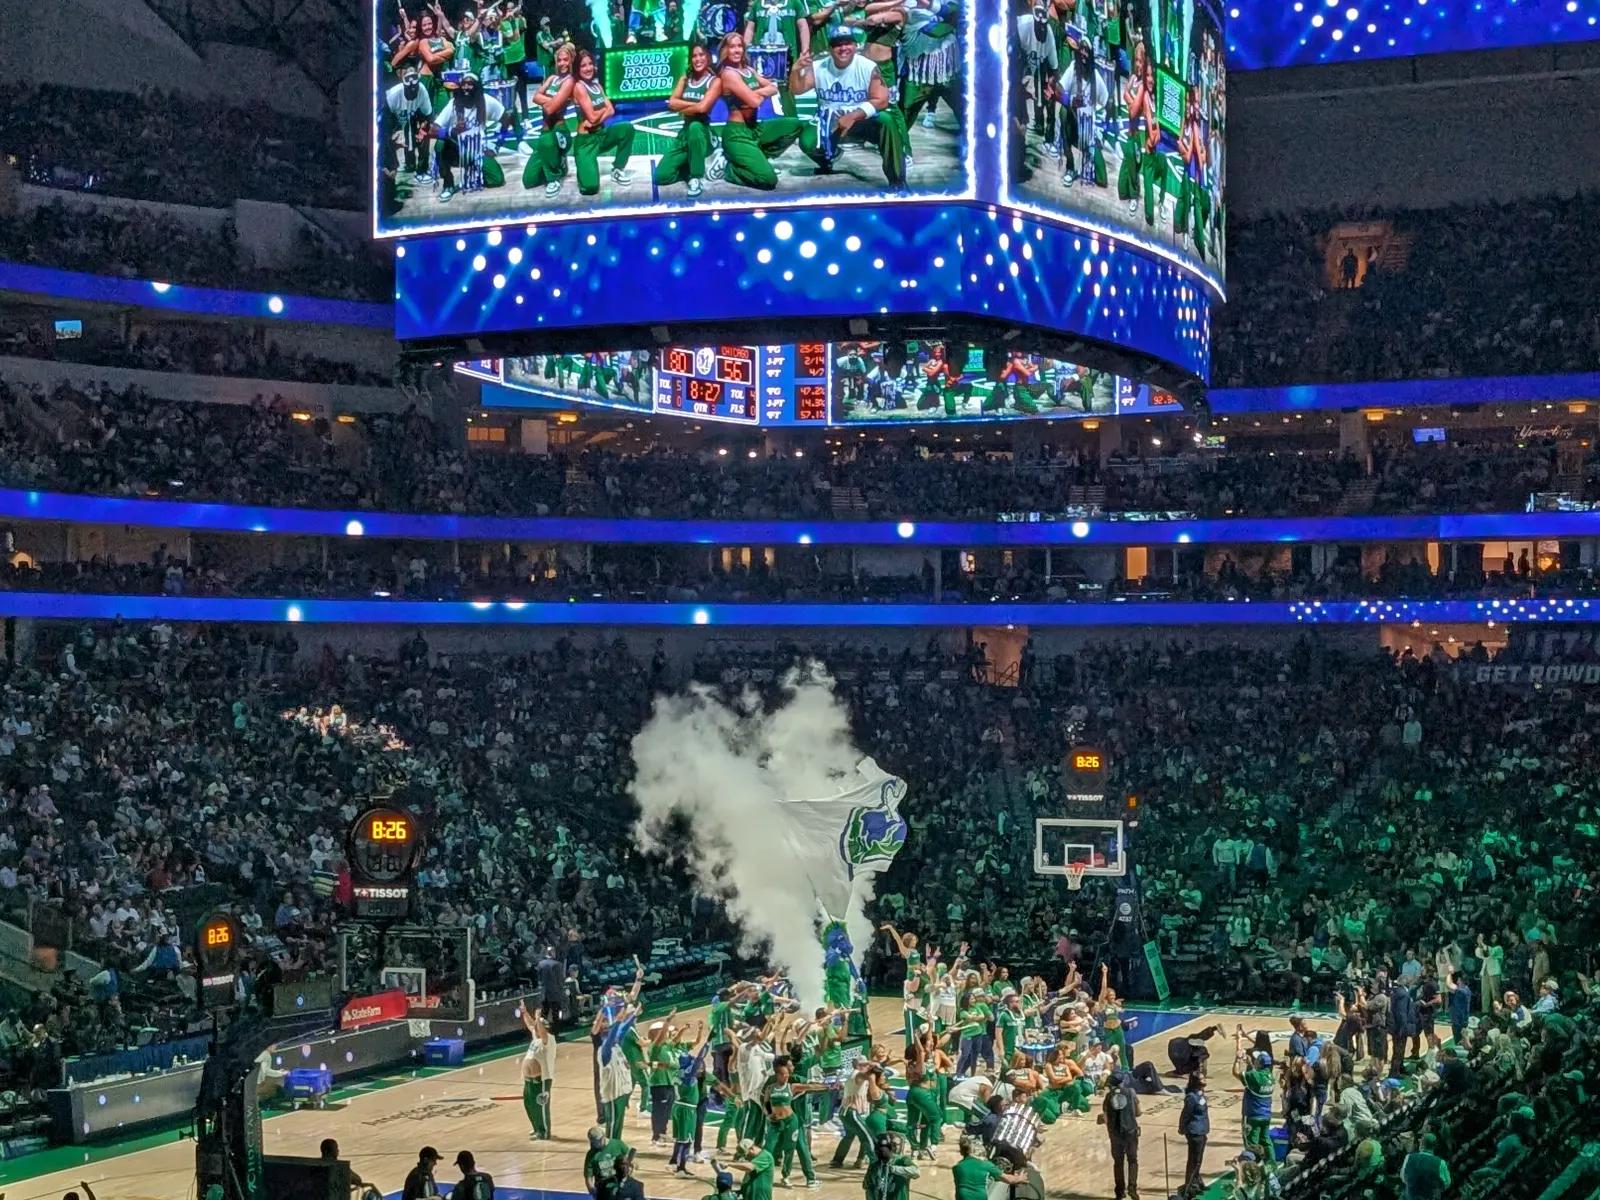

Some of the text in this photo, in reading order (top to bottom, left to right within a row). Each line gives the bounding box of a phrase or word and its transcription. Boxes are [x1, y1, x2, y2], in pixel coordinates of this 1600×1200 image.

[622, 52, 672, 66] ROWDY
[624, 65, 670, 79] PROUD
[721, 346, 749, 359] CHICAGO
[669, 351, 686, 373] 80
[804, 357, 825, 366] 2/14
[724, 360, 742, 380] 56
[659, 378, 671, 389] TOL
[690, 380, 720, 402] 8:27
[730, 389, 744, 399] TOL
[658, 394, 682, 407] FLS 0
[693, 402, 708, 413] QTR
[730, 404, 744, 414] FLS
[1476, 665, 1522, 683] GET
[1076, 756, 1100, 768] 8:26
[372, 821, 407, 839] 8:26
[370, 888, 409, 898] TISSOT
